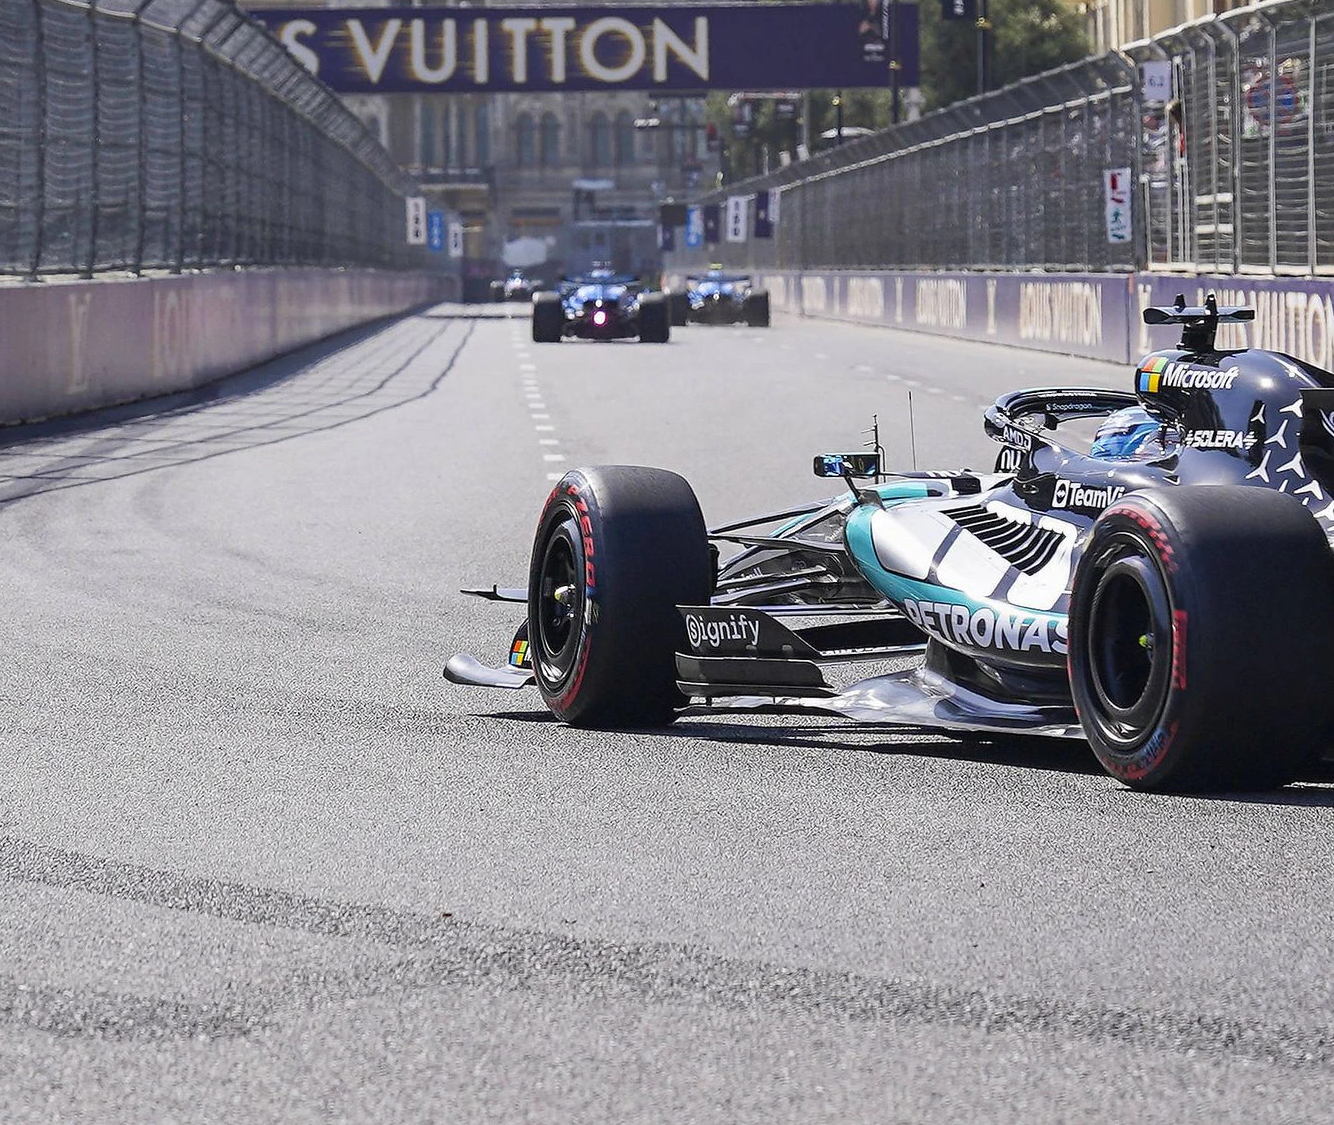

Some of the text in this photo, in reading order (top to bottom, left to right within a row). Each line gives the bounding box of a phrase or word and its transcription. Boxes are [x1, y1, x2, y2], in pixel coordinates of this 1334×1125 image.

[346, 16, 709, 84] VUITTON
[1161, 362, 1240, 390] Microsoft
[1193, 430, 1244, 449] SOLERA
[575, 498, 596, 588] ZERO
